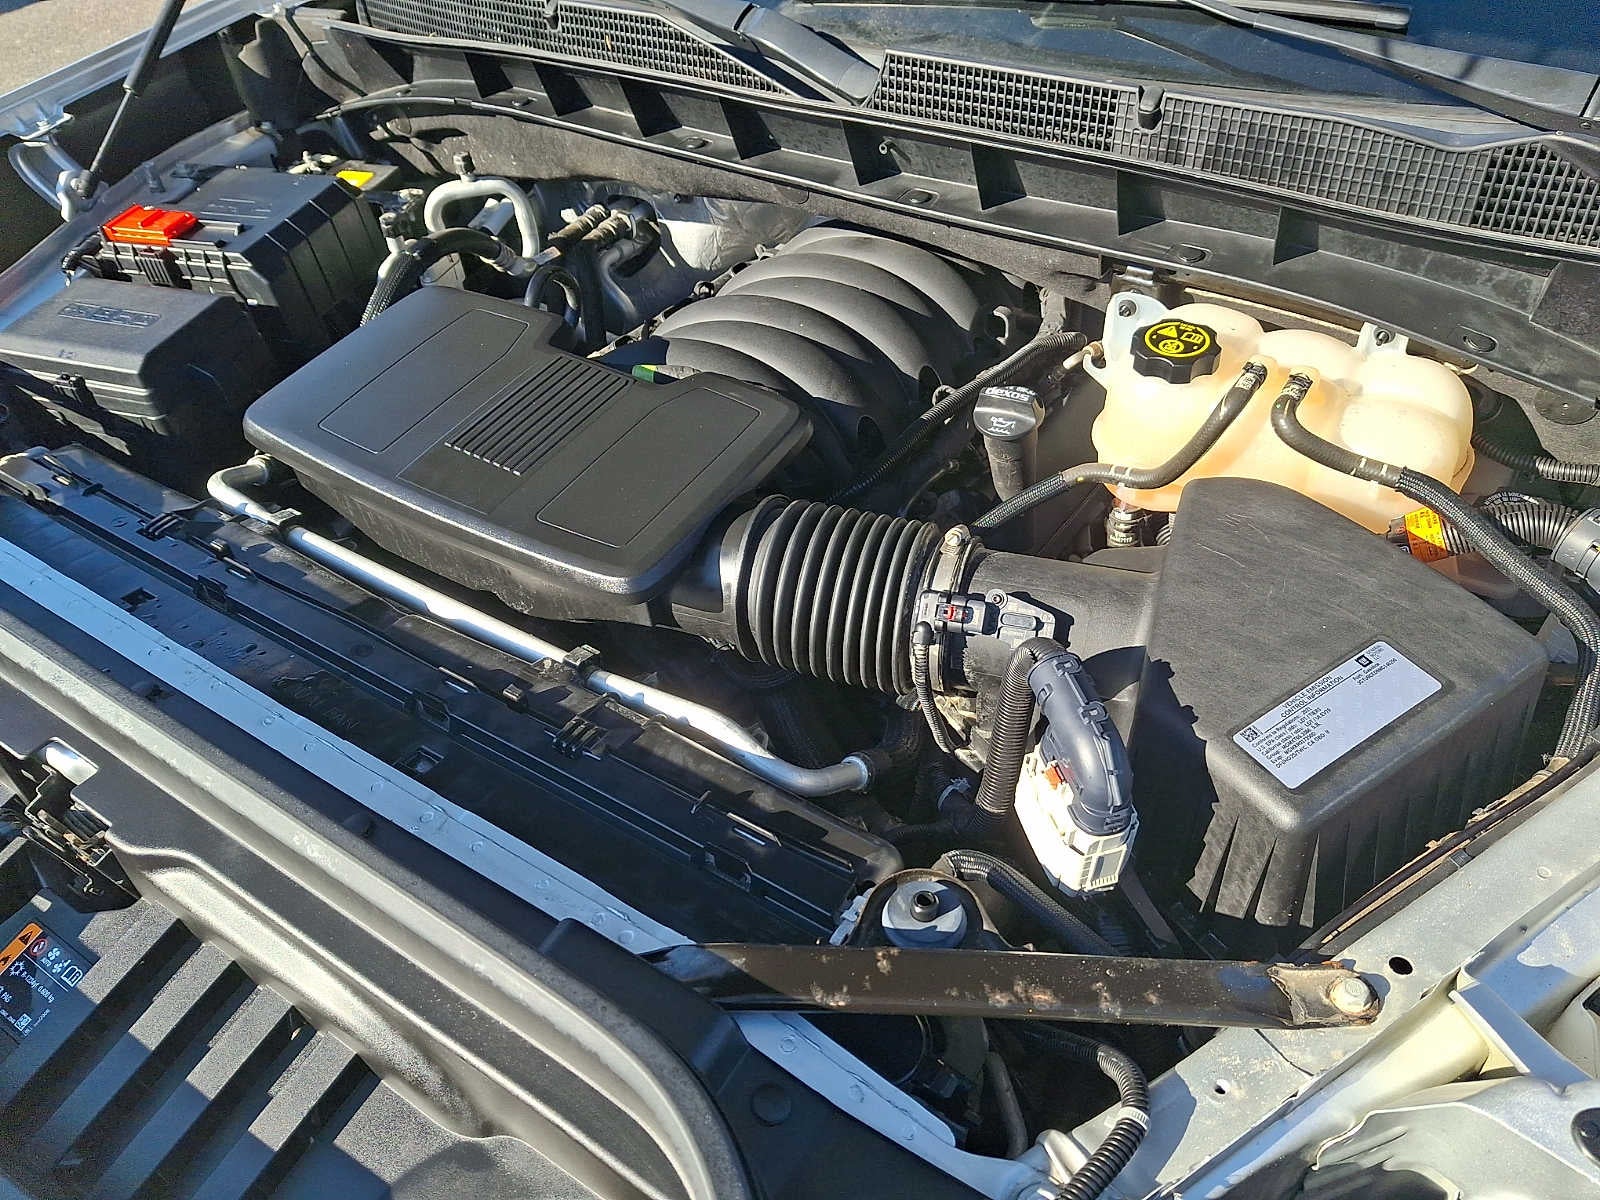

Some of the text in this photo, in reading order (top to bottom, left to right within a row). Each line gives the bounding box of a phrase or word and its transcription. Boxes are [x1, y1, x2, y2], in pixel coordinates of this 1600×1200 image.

[985, 386, 1029, 401] dexos
[1281, 675, 1344, 718] CONTROL INFORMATION
[1282, 675, 1333, 709] VEHICLE EMISSION
[20, 971, 39, 989] R-1234yf
[47, 994, 55, 1004] kg
